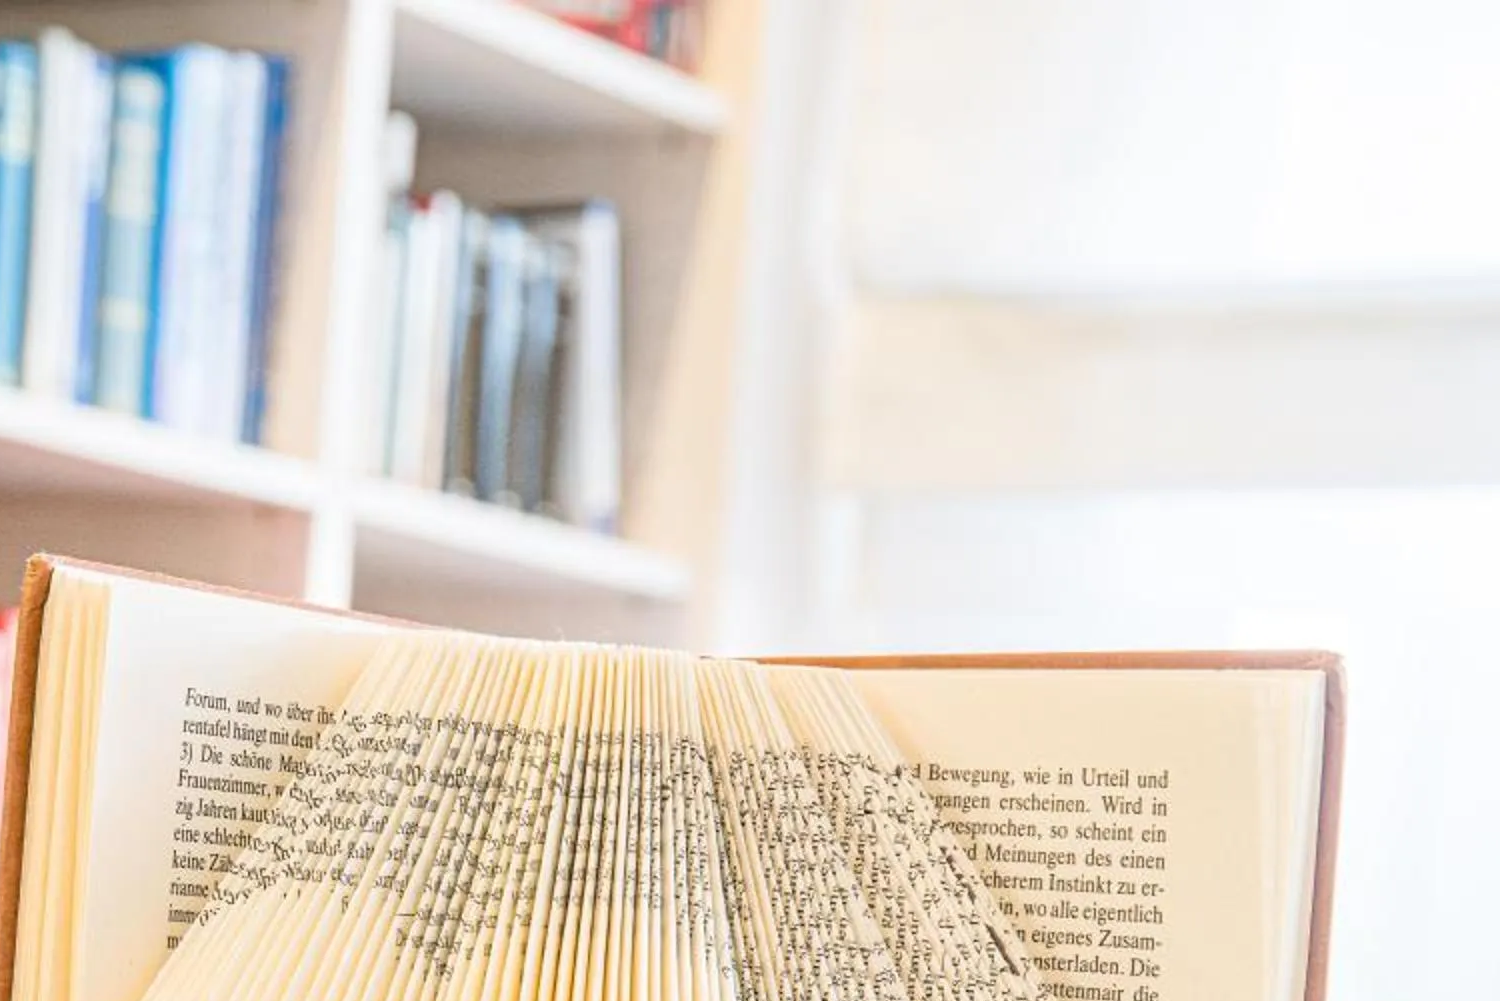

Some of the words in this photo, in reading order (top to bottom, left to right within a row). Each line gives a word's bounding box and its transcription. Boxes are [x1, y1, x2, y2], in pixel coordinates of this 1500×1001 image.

[185, 687, 231, 712] Forum,
[236, 697, 260, 715] und
[265, 703, 283, 718] wo
[287, 702, 315, 722] über
[182, 719, 231, 739] rentafel
[232, 721, 267, 747] hängt
[269, 728, 289, 745] mit
[291, 729, 314, 748] den
[200, 743, 223, 765] Die
[230, 749, 272, 770] schöne
[177, 768, 271, 799] Frauenzimmer,
[928, 763, 1015, 788] Bewegung,
[1023, 765, 1051, 785] wie
[1059, 767, 1073, 785] in
[1081, 767, 1129, 788] Urteil
[1137, 769, 1169, 789] und
[175, 797, 193, 821] zig
[196, 798, 237, 820] Jahren
[1000, 791, 1091, 813] erscheinen.
[1101, 795, 1143, 815] Wird
[1152, 796, 1167, 816] in
[173, 824, 200, 843] eine
[1050, 825, 1069, 839] so
[1075, 822, 1133, 841] scheint
[1141, 824, 1167, 843] ein
[172, 849, 205, 870] keine
[986, 843, 1076, 869] Meinungen
[1085, 847, 1112, 867] des
[1120, 849, 1165, 870] einen
[1049, 873, 1112, 894] Instinkt
[1116, 881, 1135, 894] zu
[1141, 882, 1165, 896] er-
[1023, 903, 1047, 916] wo
[1050, 899, 1079, 919] alle
[1083, 901, 1163, 926] eigentlich
[1031, 926, 1093, 948] eigenes
[1098, 929, 1163, 951] Zusam-
[1130, 957, 1161, 977] Die
